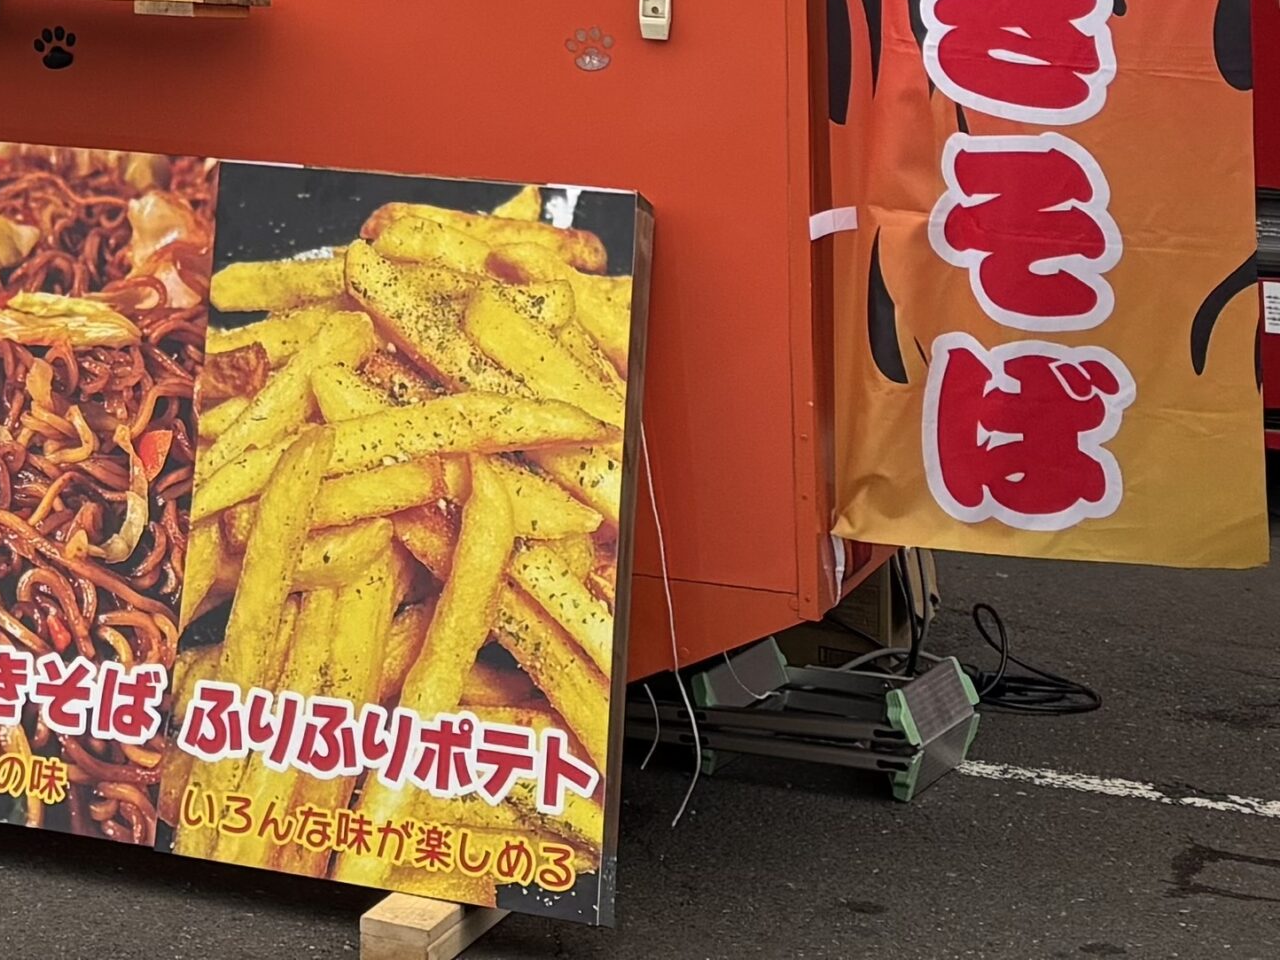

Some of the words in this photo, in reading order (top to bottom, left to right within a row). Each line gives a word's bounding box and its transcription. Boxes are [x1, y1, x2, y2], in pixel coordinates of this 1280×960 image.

[178, 680, 599, 814] ふりふりポテト
[181, 786, 576, 891] いろんな味が楽しめる
